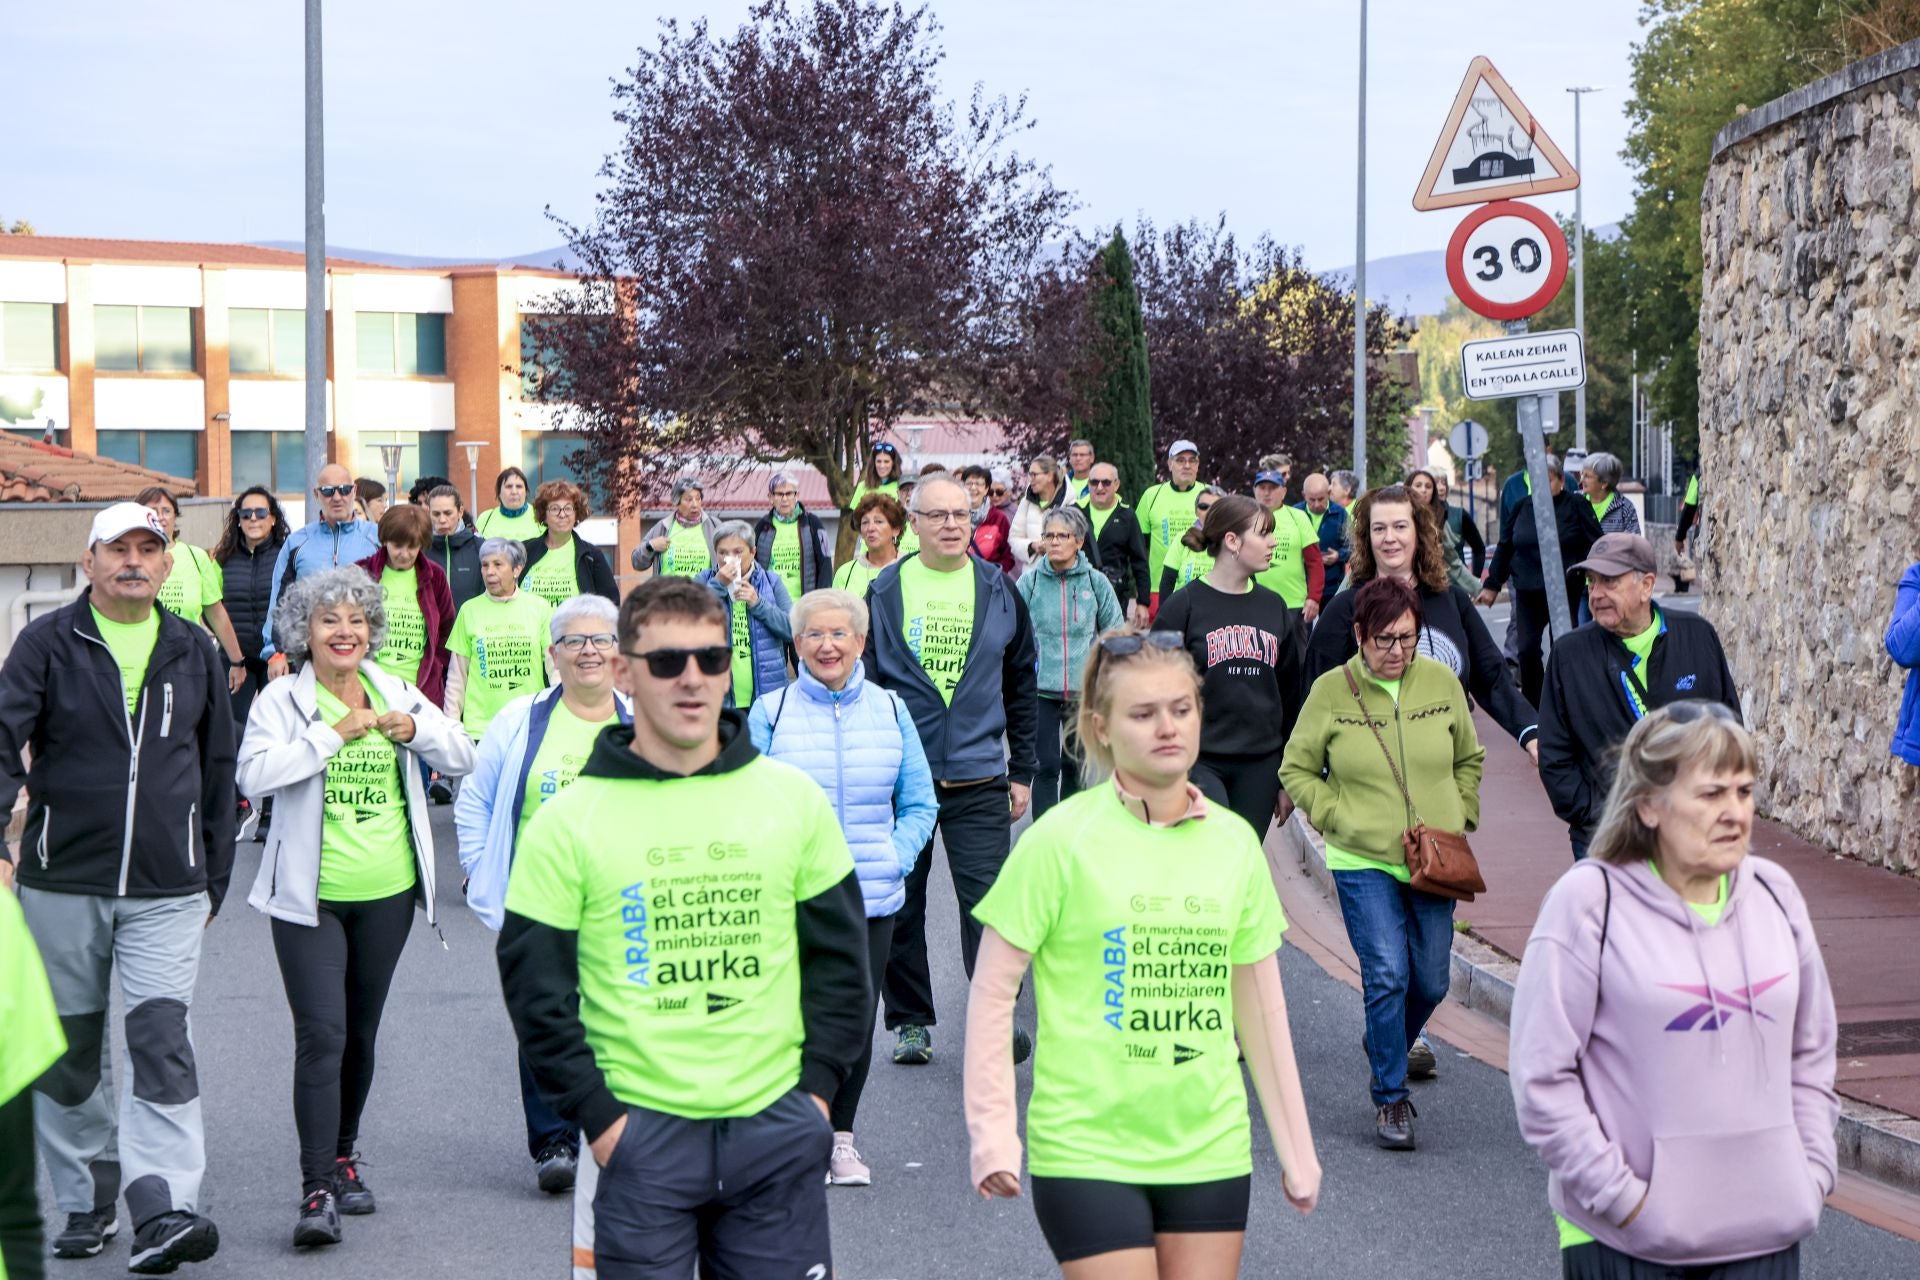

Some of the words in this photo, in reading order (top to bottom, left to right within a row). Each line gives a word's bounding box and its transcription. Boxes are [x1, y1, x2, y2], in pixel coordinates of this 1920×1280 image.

[1473, 237, 1541, 281] 30
[1476, 348, 1524, 362] KALEAN
[1526, 343, 1568, 356] ZEHAR
[1471, 378, 1487, 388] EN
[1523, 372, 1538, 382] LA
[1540, 367, 1579, 379] CALLE
[926, 622, 938, 632] el
[488, 648, 532, 658] martxan
[1206, 624, 1278, 669] BROOKLYN
[489, 665, 531, 679] aurka
[1227, 666, 1241, 675] NEW
[1244, 667, 1261, 676] YORK
[325, 787, 387, 805] aurka
[650, 877, 667, 889] En
[671, 873, 718, 887] marcha
[722, 872, 762, 883] contra
[652, 889, 675, 909] el
[682, 885, 762, 906] cáncer
[655, 907, 760, 932] martxan
[620, 881, 649, 987] ARABA
[1132, 924, 1147, 935] En
[1150, 924, 1193, 936] marcha
[655, 932, 762, 951] minbiziaren
[1132, 937, 1152, 956] el
[657, 950, 760, 985] aurka
[1132, 959, 1228, 979] martxan
[1103, 925, 1127, 1031] ARABA
[1131, 983, 1225, 998] minbiziaren
[1130, 1001, 1223, 1032] aurka
